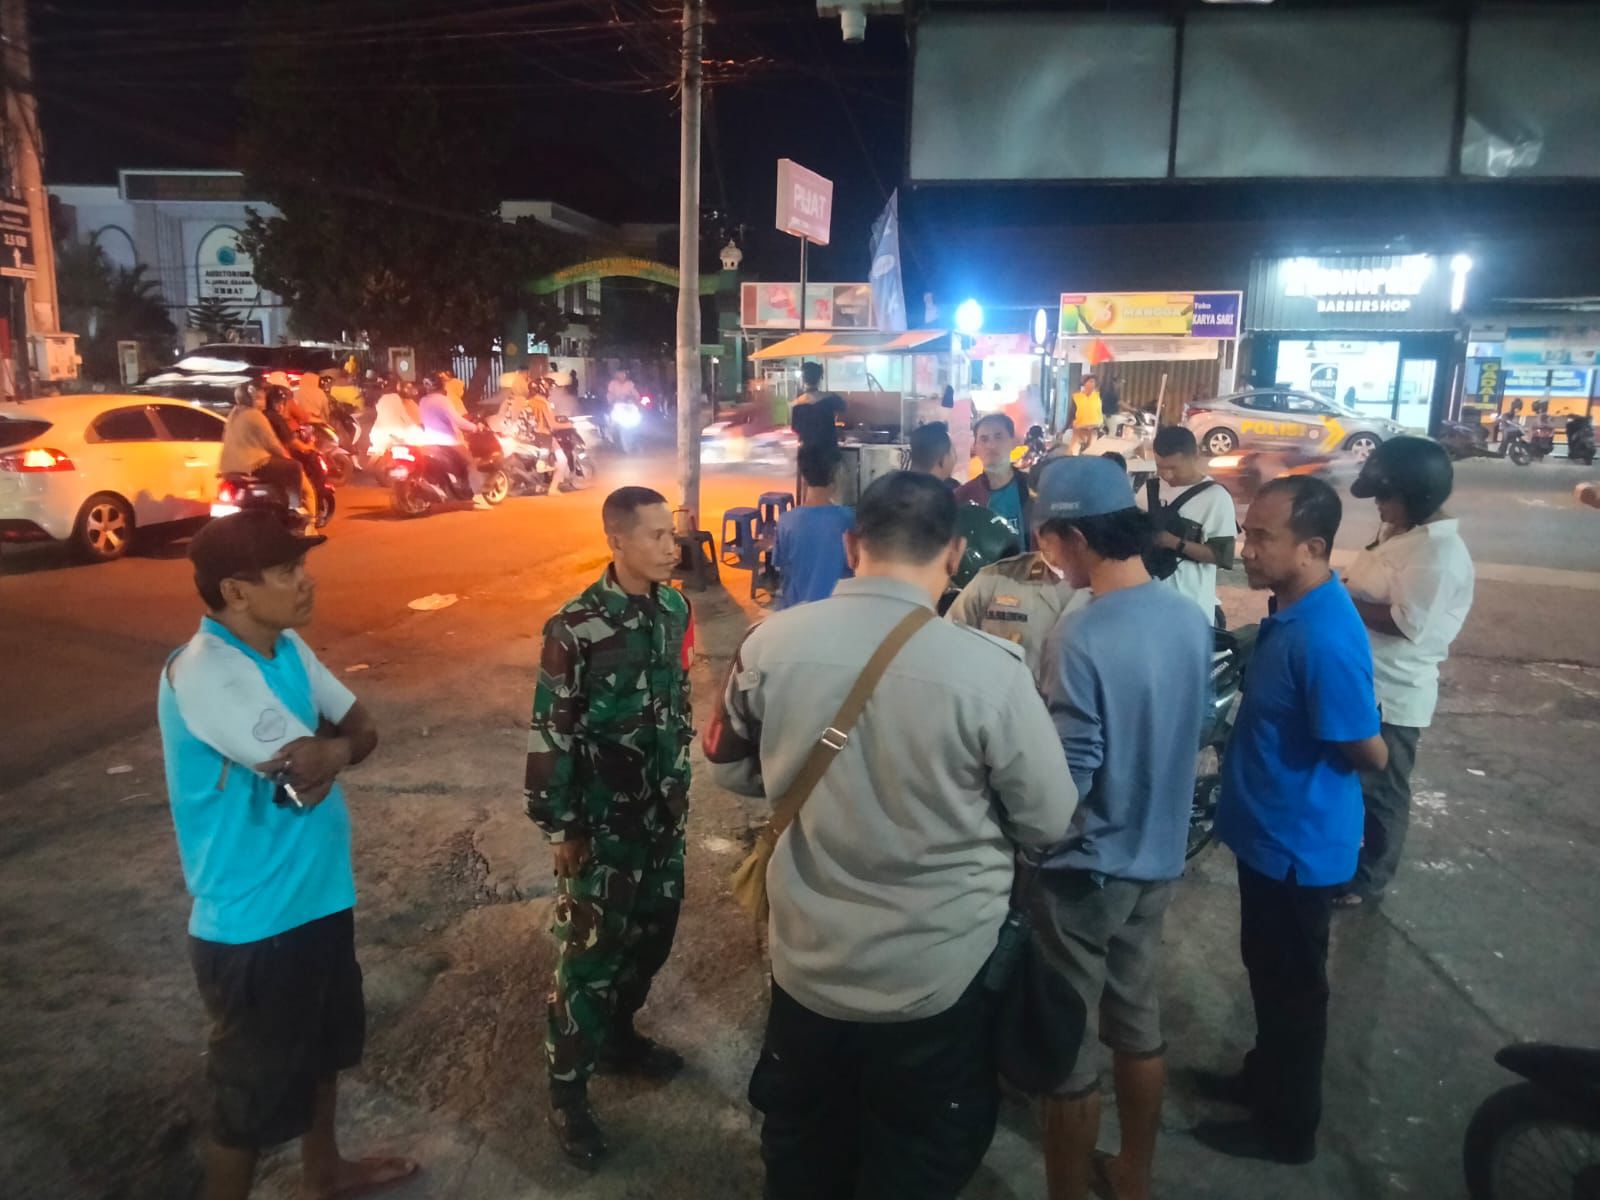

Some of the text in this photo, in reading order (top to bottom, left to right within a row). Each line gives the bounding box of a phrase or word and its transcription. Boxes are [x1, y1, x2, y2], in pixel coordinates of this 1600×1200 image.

[1316, 299, 1411, 312] BARBERSHOP
[1192, 313, 1234, 326] KARYA SARI
